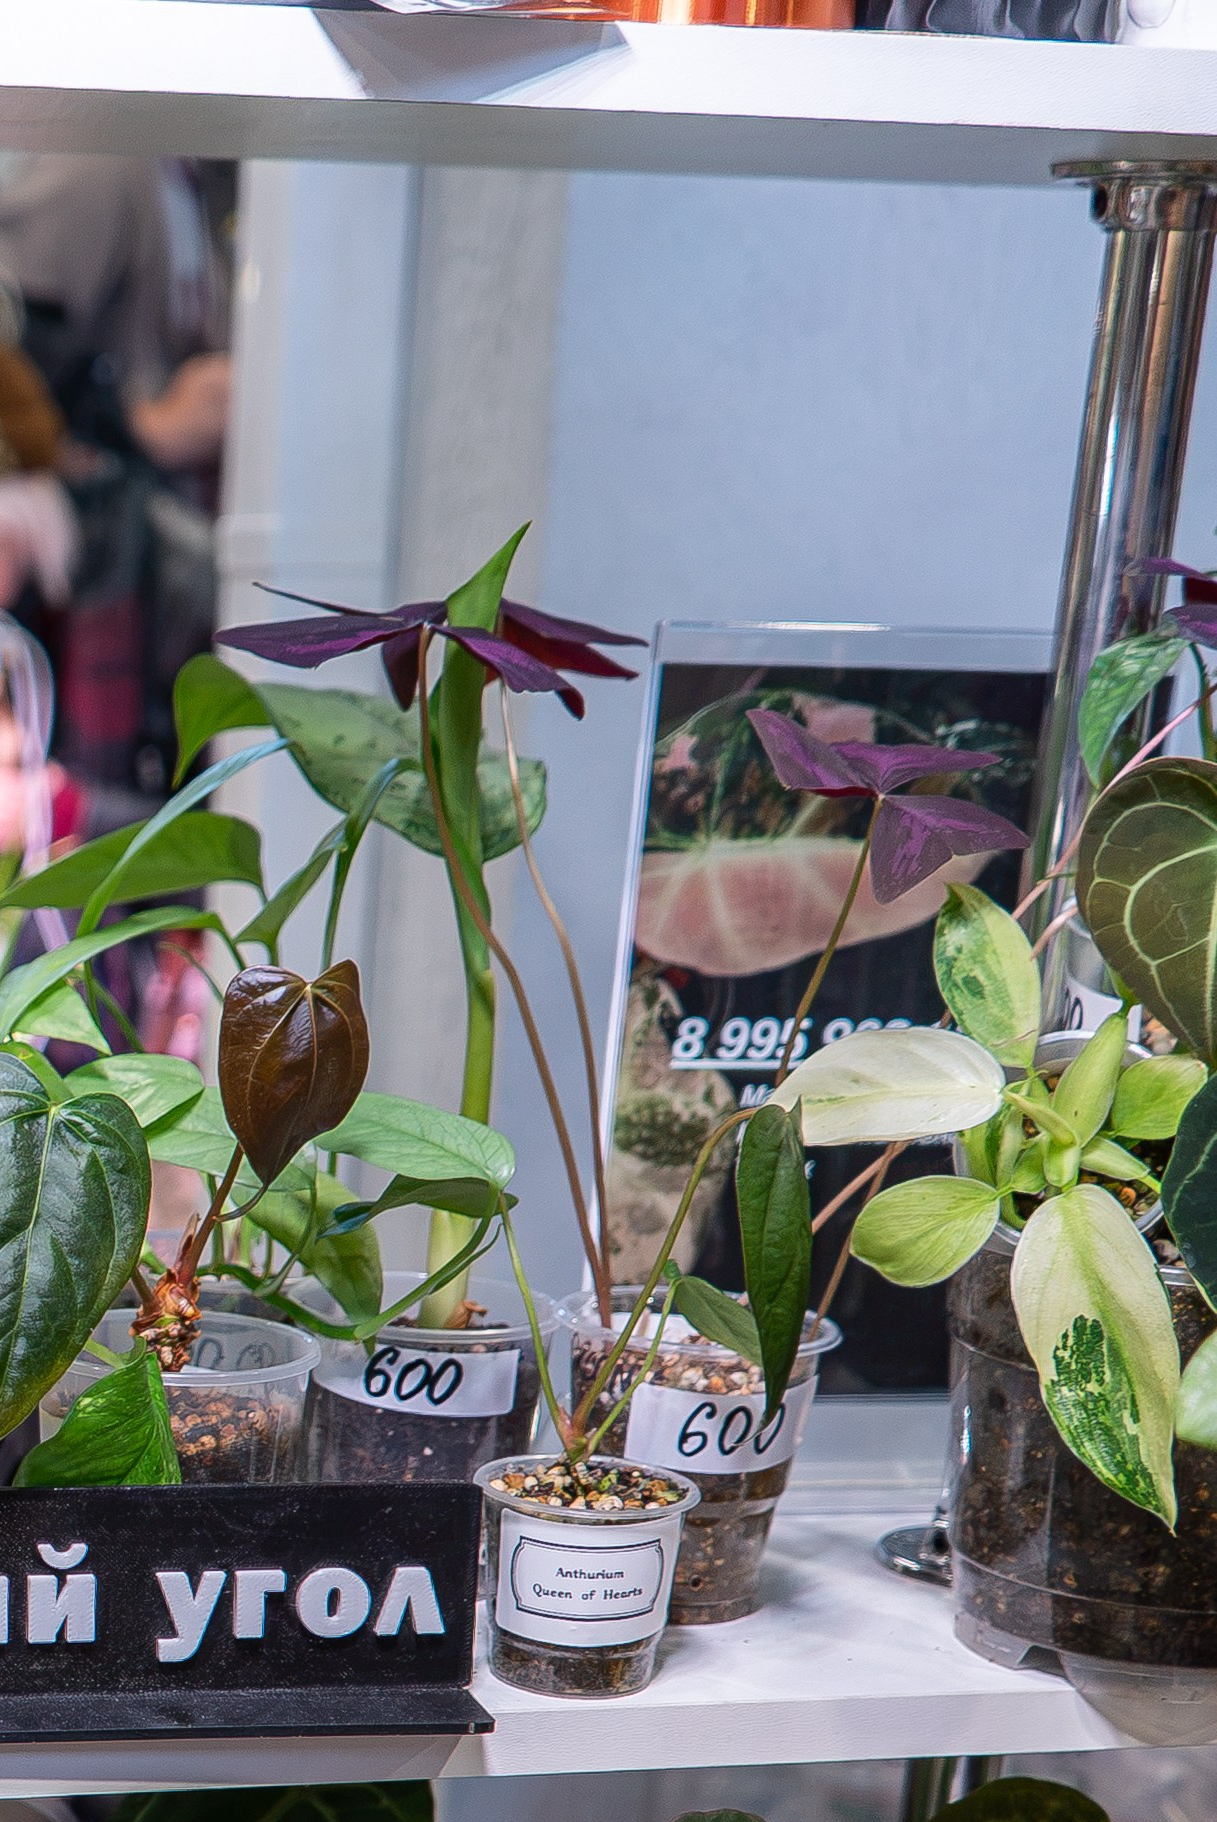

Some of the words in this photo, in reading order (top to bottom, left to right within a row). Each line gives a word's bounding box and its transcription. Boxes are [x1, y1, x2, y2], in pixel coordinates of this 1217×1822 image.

[671, 1016, 709, 1059] 8
[716, 1016, 813, 1060] 995
[363, 1347, 464, 1406] 600
[678, 1401, 786, 1457] 600
[532, 1583, 572, 1599] Queen
[581, 1589, 597, 1601] of
[603, 1587, 643, 1600] Hearts
[556, 1567, 624, 1579] Anthurium
[156, 1566, 445, 1663] угол
